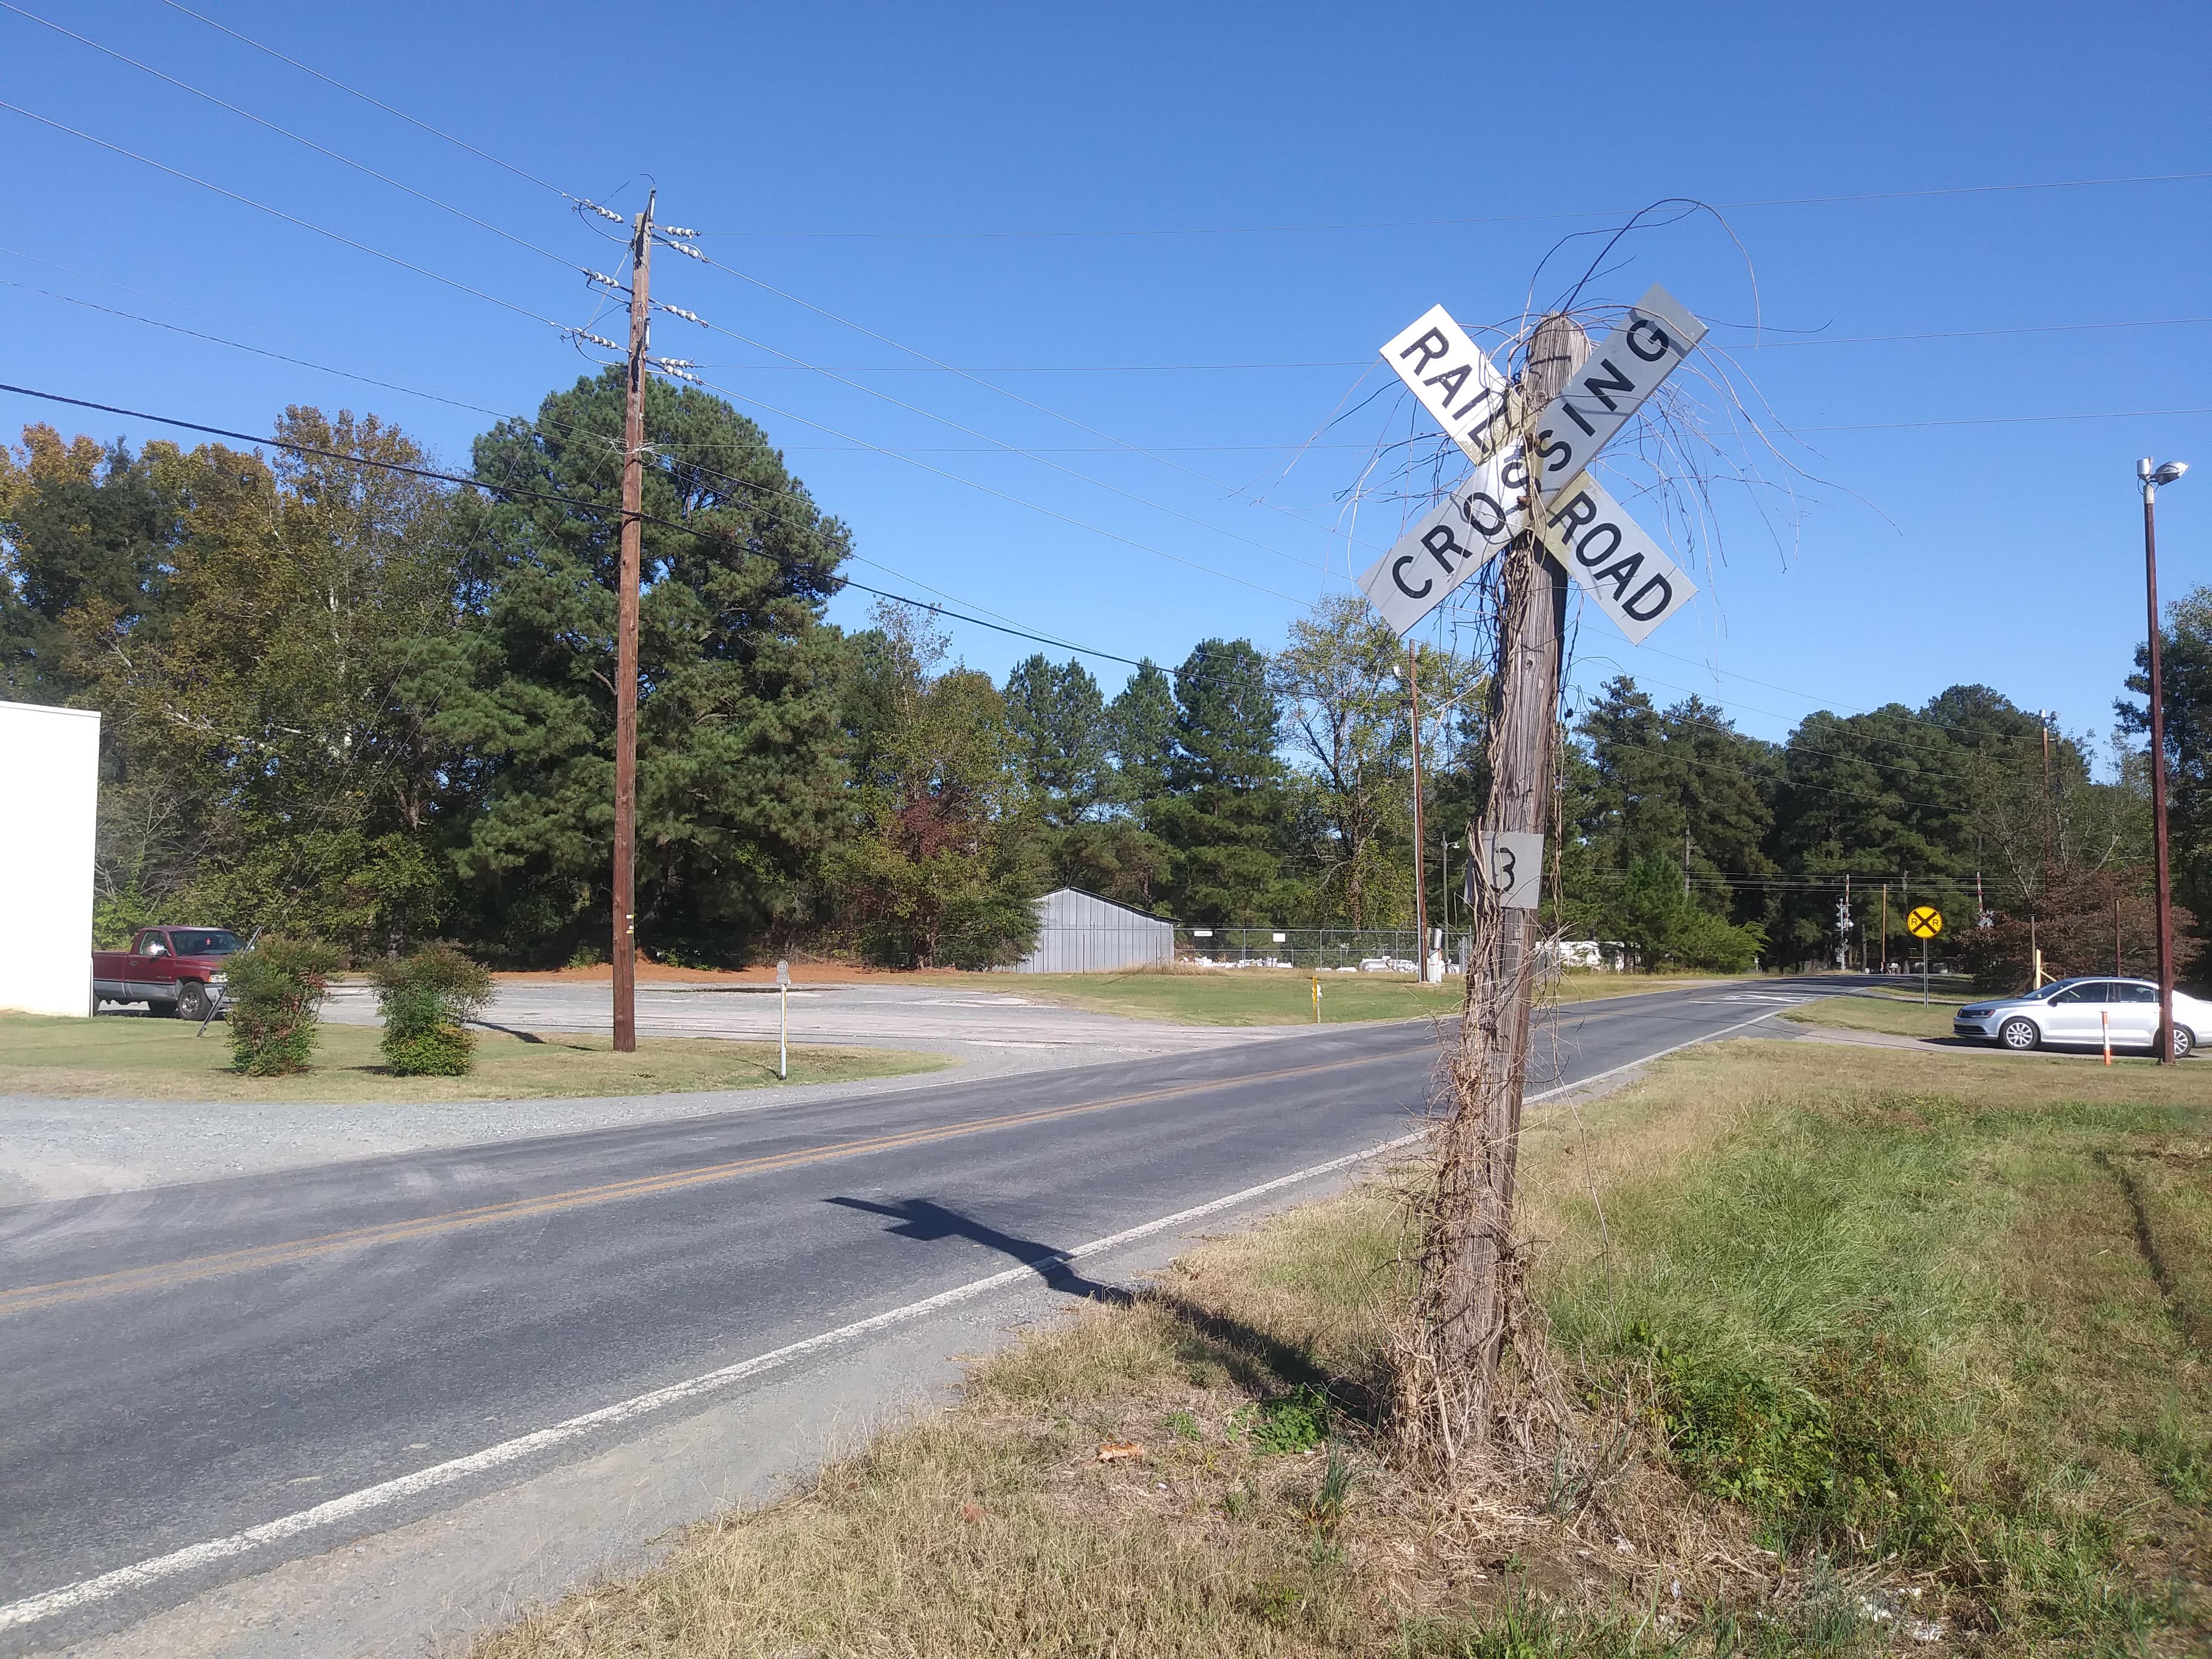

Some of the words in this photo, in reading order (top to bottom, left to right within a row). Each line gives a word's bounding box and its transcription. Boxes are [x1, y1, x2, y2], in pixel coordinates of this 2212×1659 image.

[1392, 319, 1669, 599] CROSSING
[1400, 326, 1508, 455] RAIL
[1548, 490, 1672, 622] ROAD
[1489, 847, 1515, 894] 3
